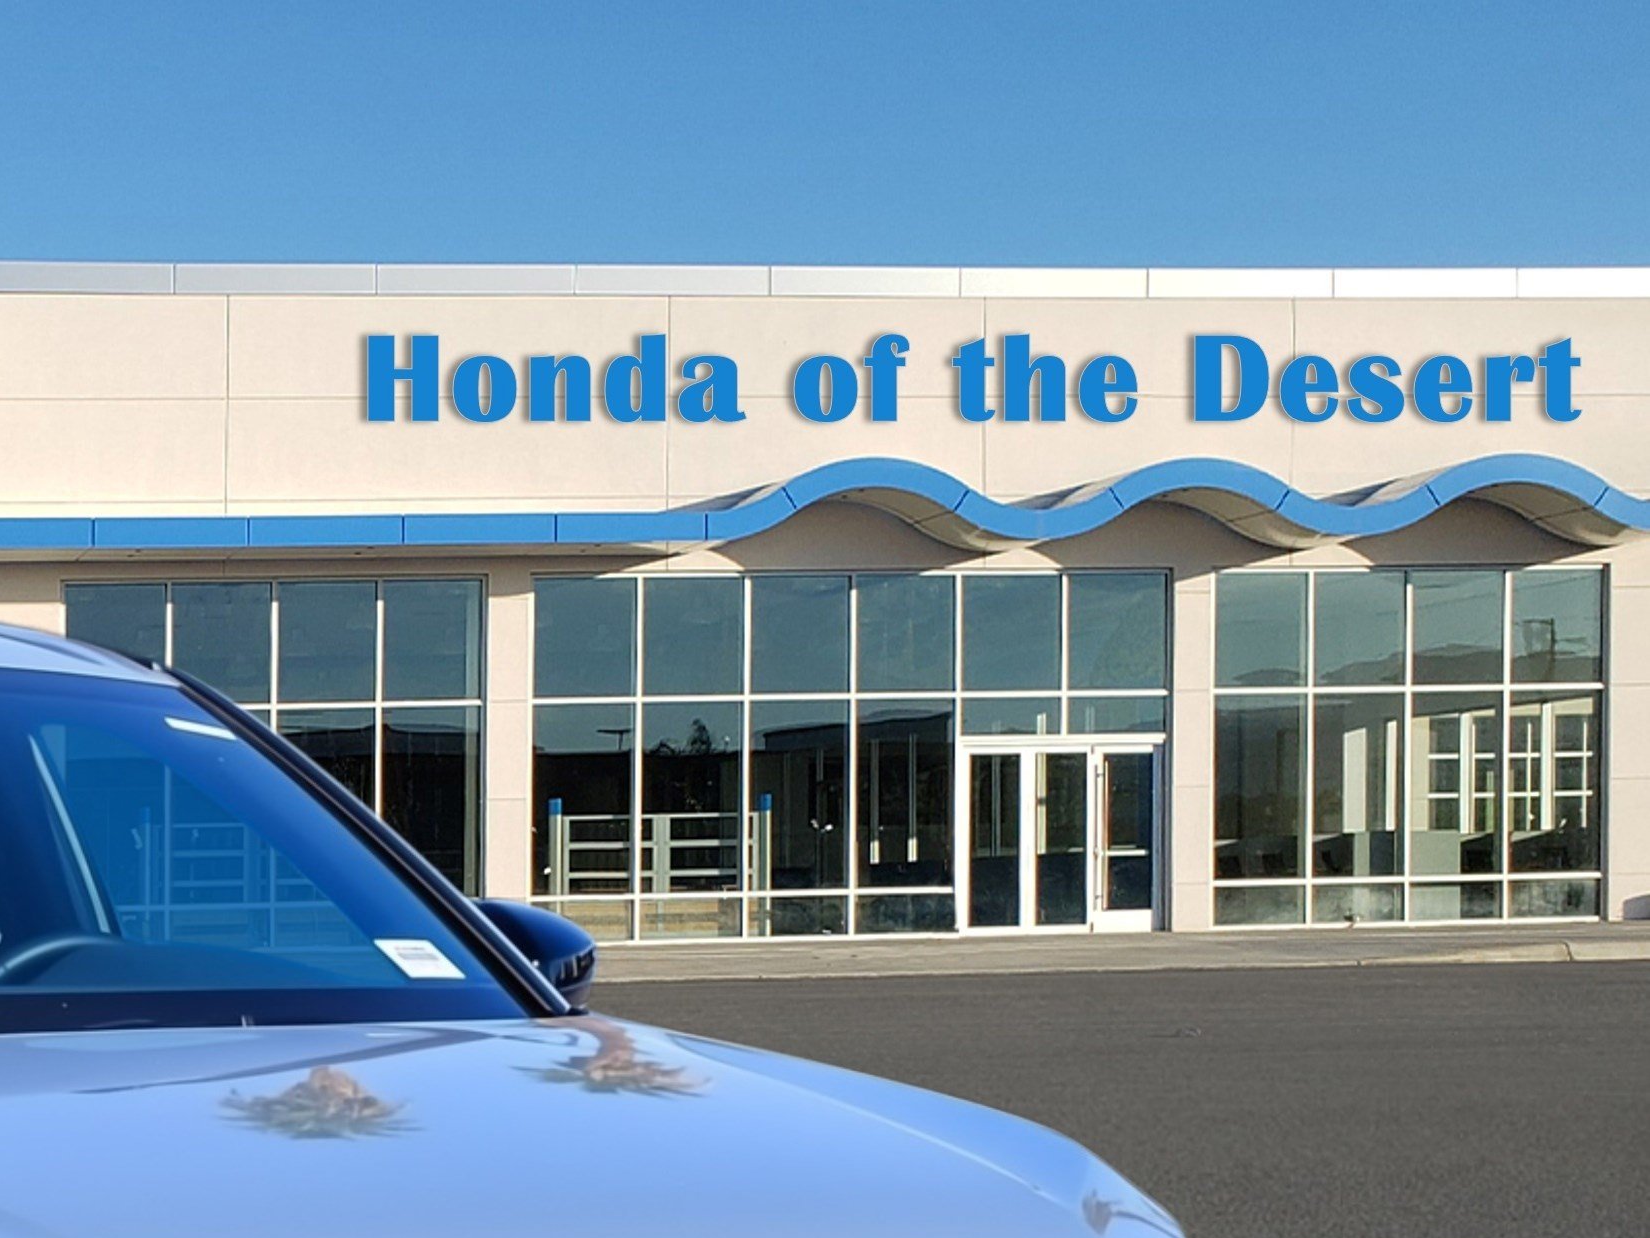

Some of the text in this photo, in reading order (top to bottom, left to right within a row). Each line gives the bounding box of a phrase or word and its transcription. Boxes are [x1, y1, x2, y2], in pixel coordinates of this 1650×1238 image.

[365, 332, 1583, 424] Honda of the Desert
